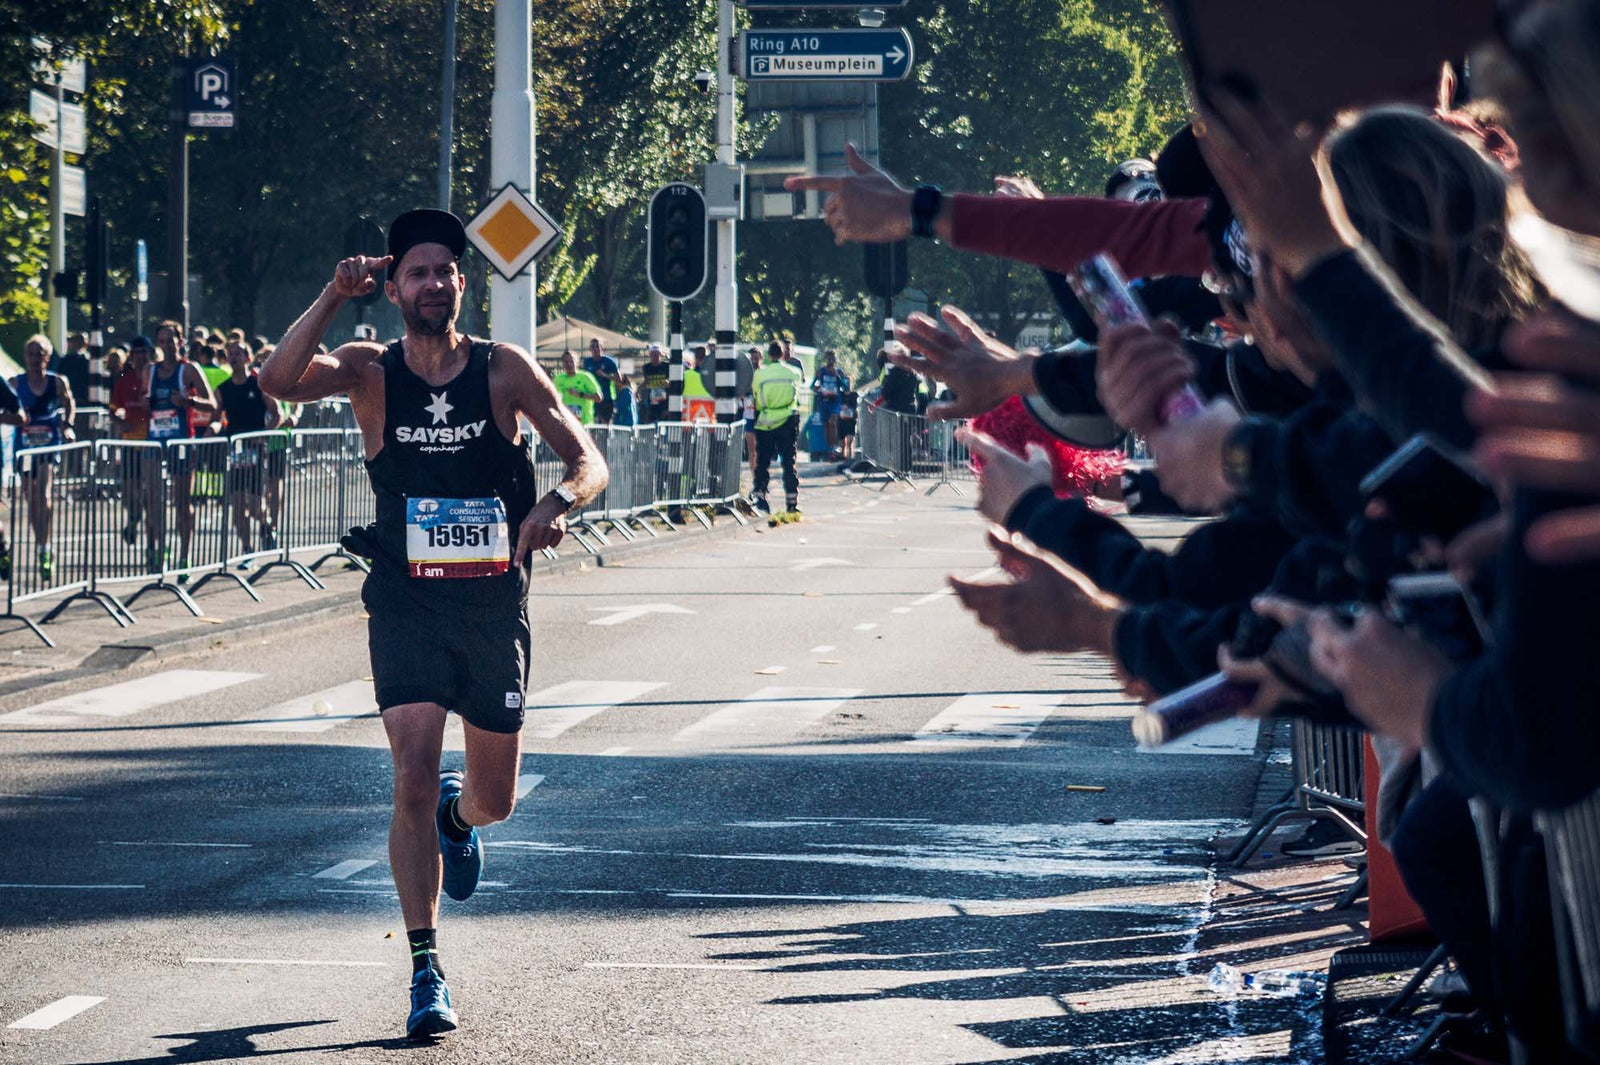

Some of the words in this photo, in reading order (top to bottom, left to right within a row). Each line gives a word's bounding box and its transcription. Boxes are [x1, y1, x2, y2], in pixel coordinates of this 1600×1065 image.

[750, 38, 784, 53] Ring
[791, 38, 819, 51] A10
[773, 58, 876, 72] Museumplein
[202, 74, 221, 101] P
[671, 186, 687, 195] 112
[395, 419, 487, 443] SAYSKY
[420, 444, 465, 454] copenhagen
[463, 500, 486, 508] TATA
[458, 515, 491, 523] SERVICES
[426, 524, 490, 548] 15951
